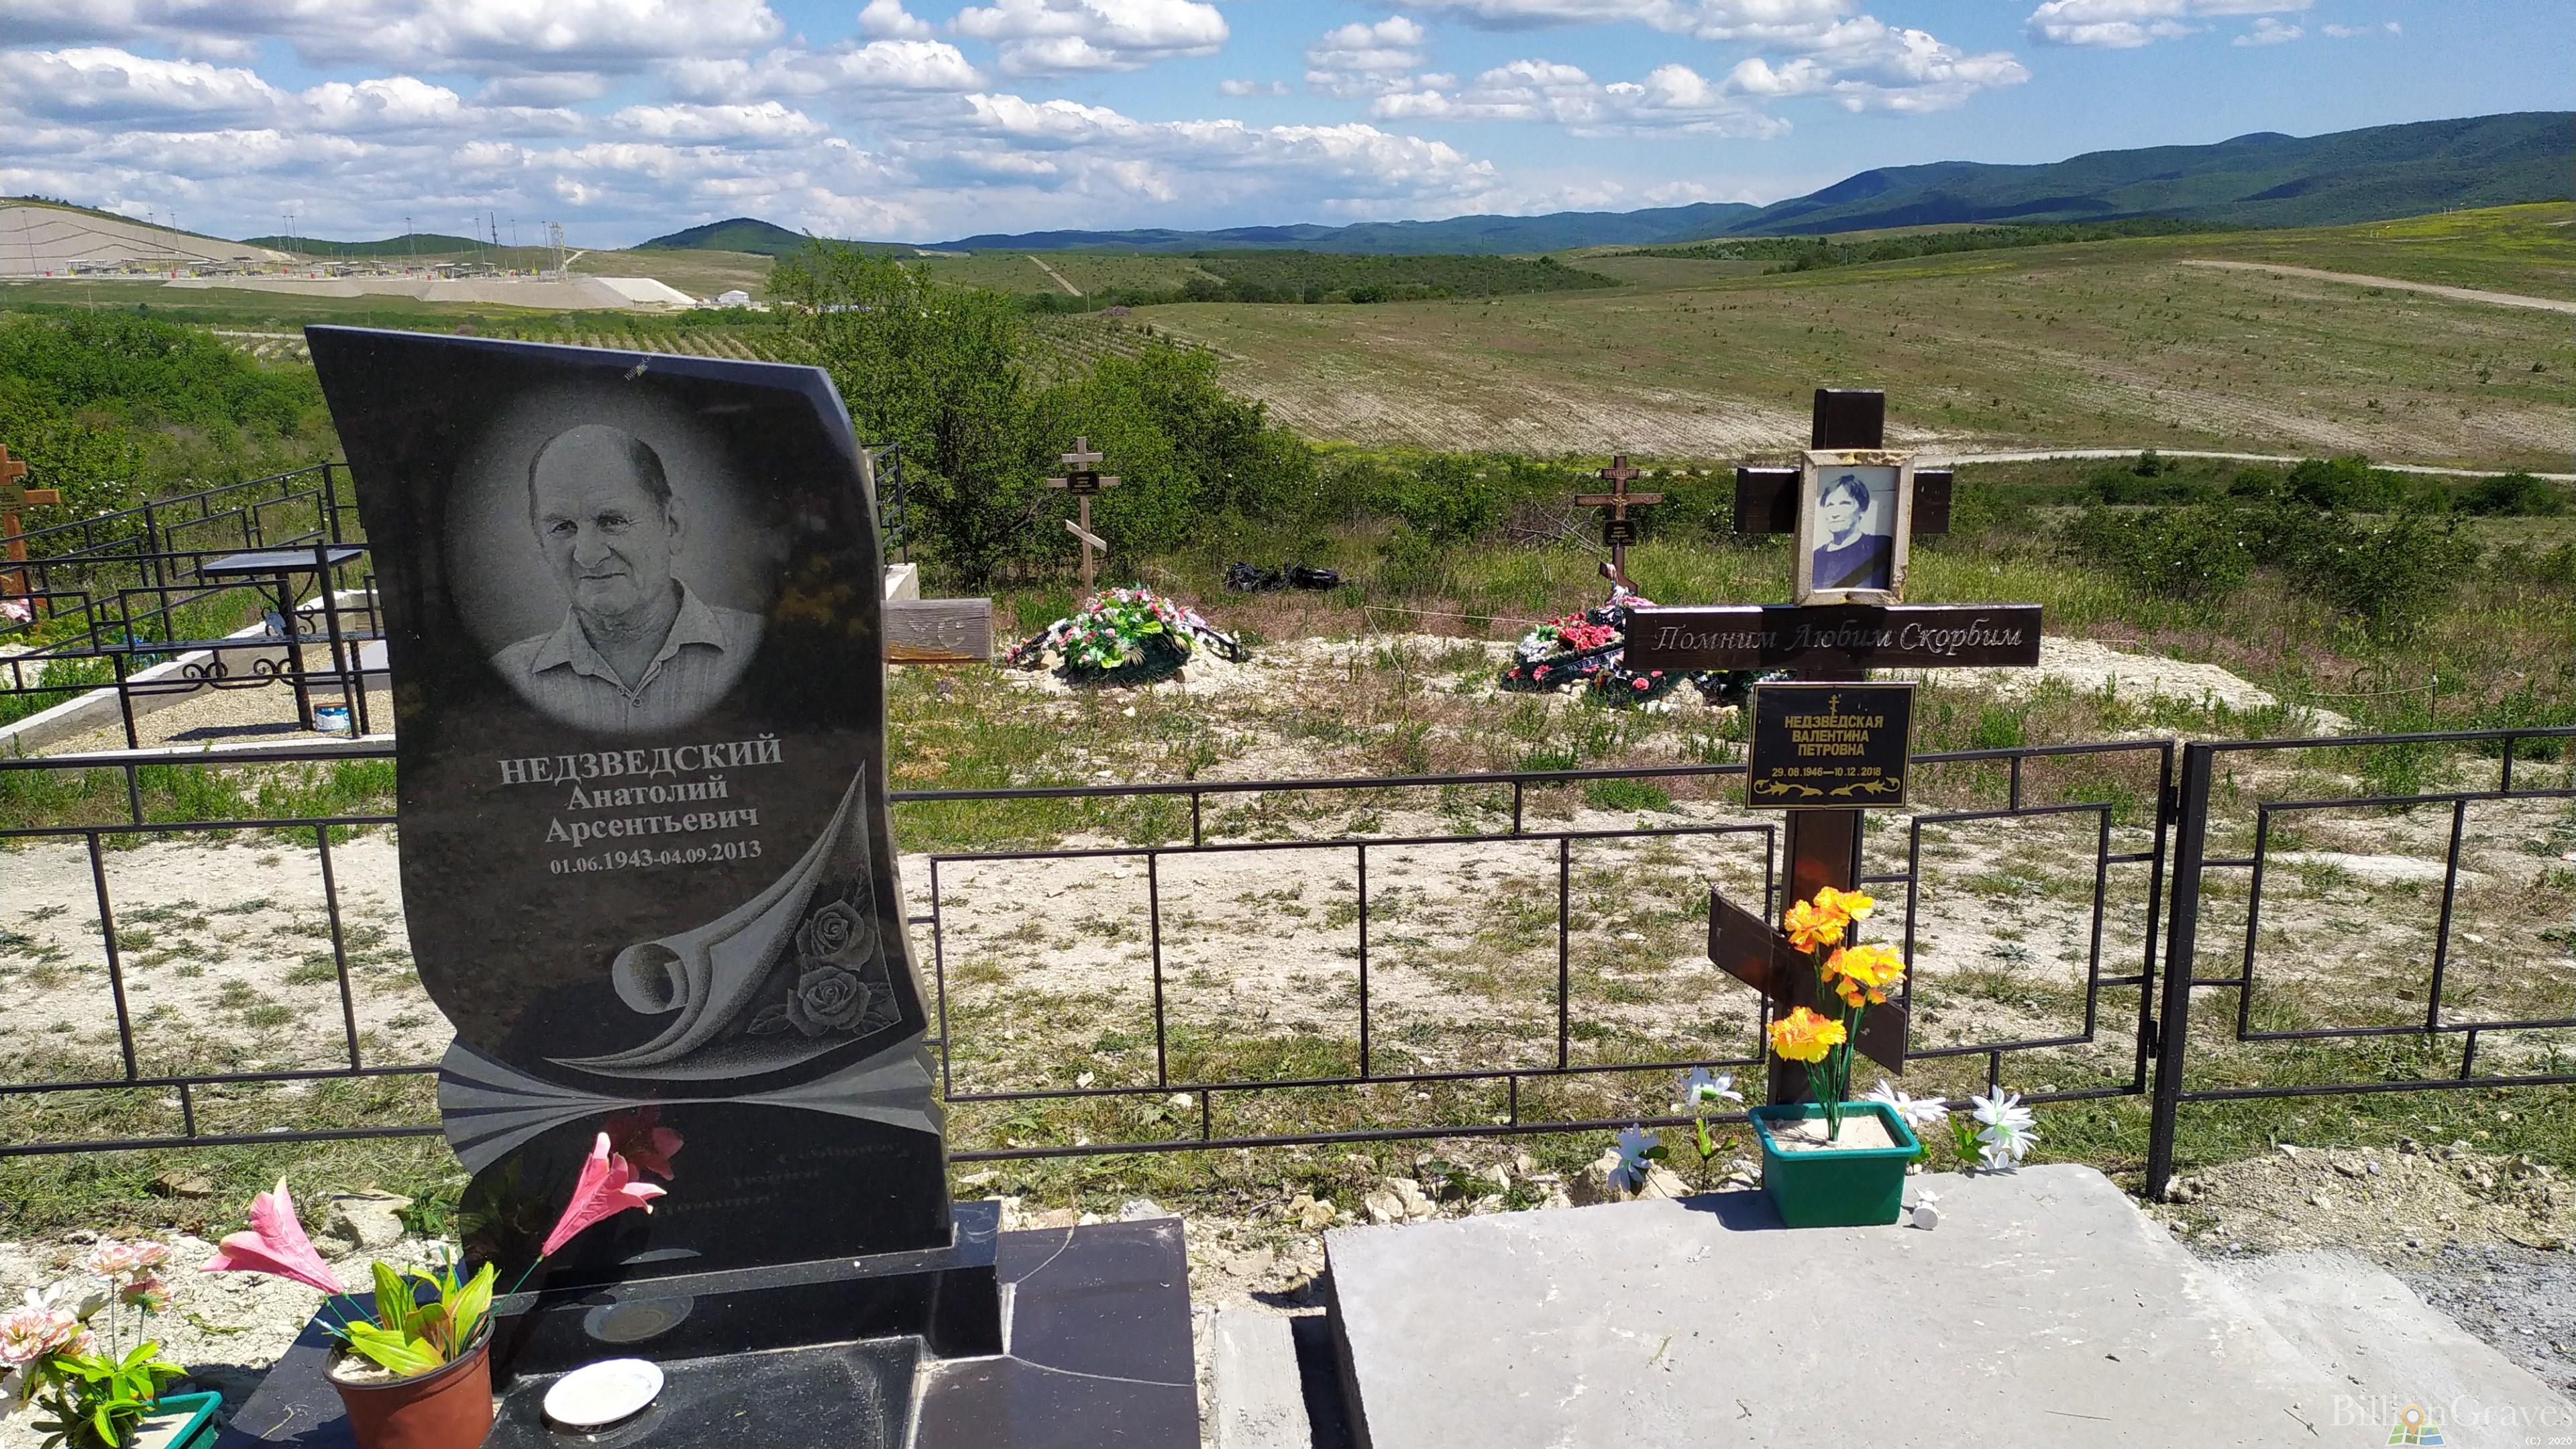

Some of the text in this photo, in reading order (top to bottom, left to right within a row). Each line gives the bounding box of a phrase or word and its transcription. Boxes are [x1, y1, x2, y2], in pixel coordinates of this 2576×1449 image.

[1651, 618, 2023, 655] Помним Любим Скорбим
[1784, 715, 1884, 729] НЕДЗВЕДСКАЯ
[1792, 730, 1870, 743] ВАЛЕНТИНА
[498, 733, 784, 786] НЕДЗВЕДСКИЙ
[1798, 743, 1865, 757] ПЕТРОВНА
[566, 774, 729, 810] Анатолий
[545, 808, 759, 847] Арсентьевич
